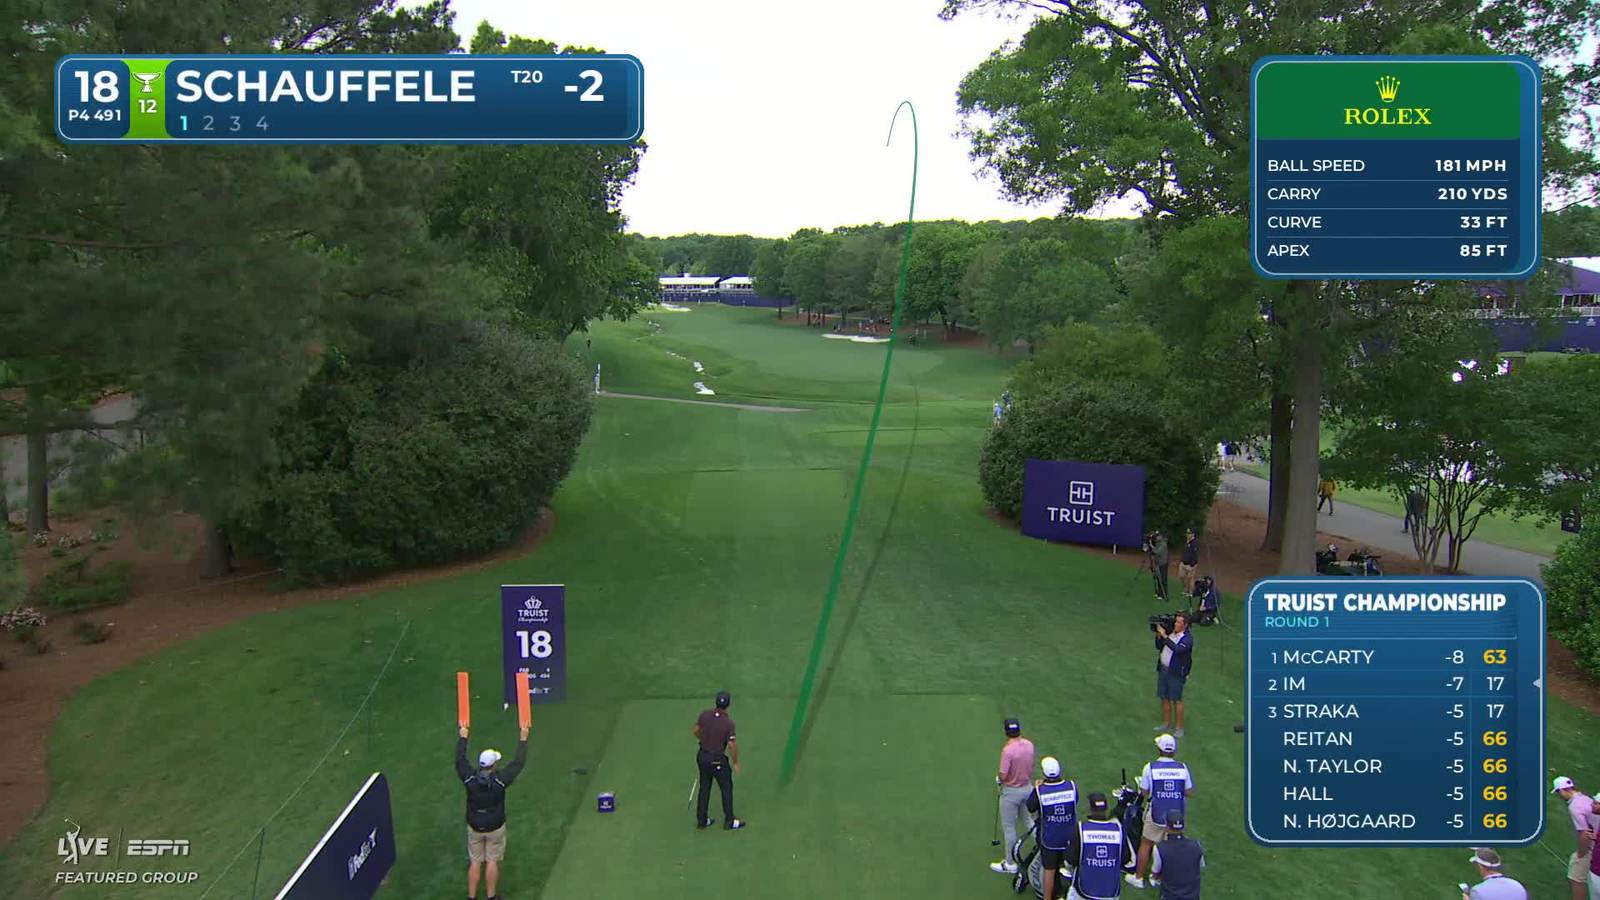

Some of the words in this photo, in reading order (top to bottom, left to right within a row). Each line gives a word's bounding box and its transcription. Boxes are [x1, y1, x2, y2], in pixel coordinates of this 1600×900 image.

[1047, 507, 1115, 526] TRUIST
[516, 630, 552, 658] 18
[1086, 858, 1116, 867] TRUIST
